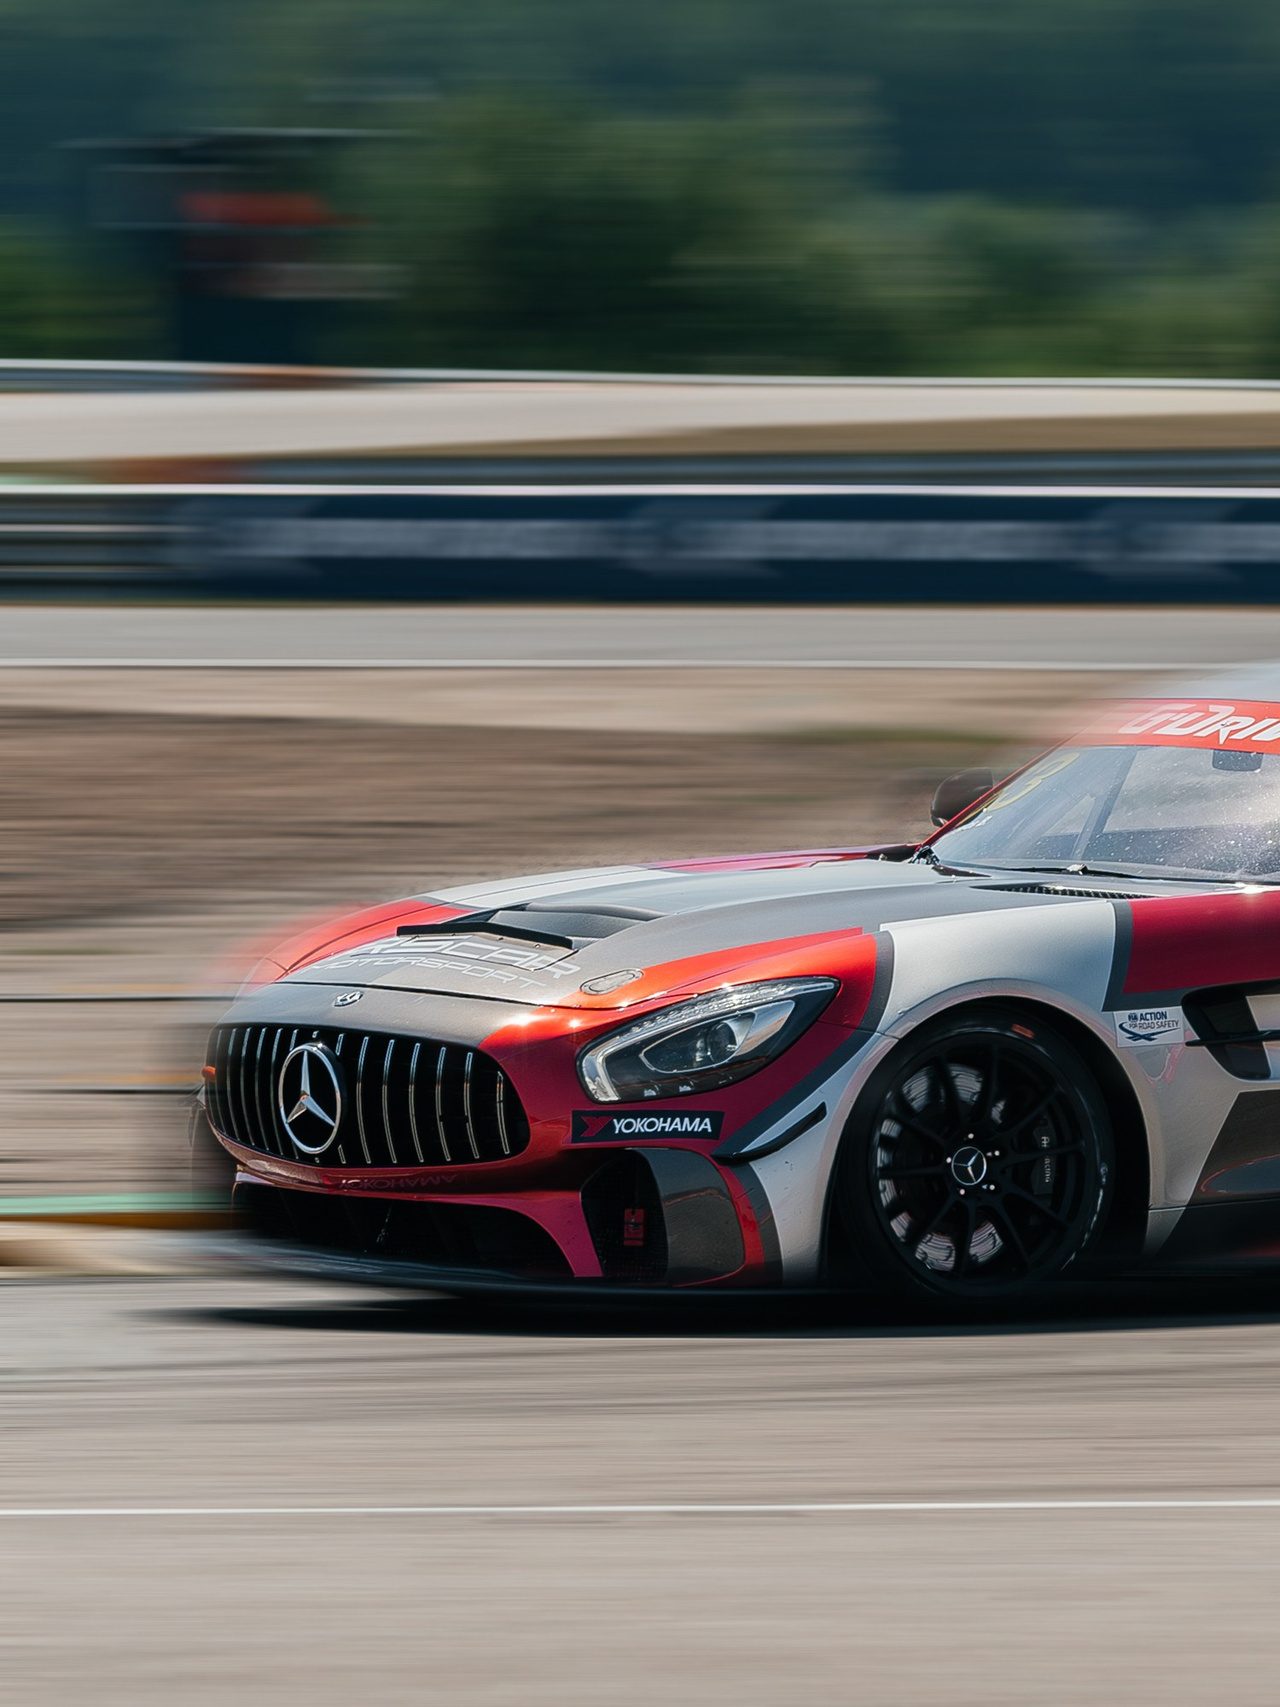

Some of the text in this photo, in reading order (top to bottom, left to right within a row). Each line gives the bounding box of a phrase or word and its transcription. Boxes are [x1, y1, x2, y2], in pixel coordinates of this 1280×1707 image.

[1139, 1011, 1168, 1021] ACTION
[1138, 1021, 1155, 1029] ROAD
[1156, 1019, 1179, 1029] SAFETY
[612, 1117, 712, 1134] YOKOHAMA
